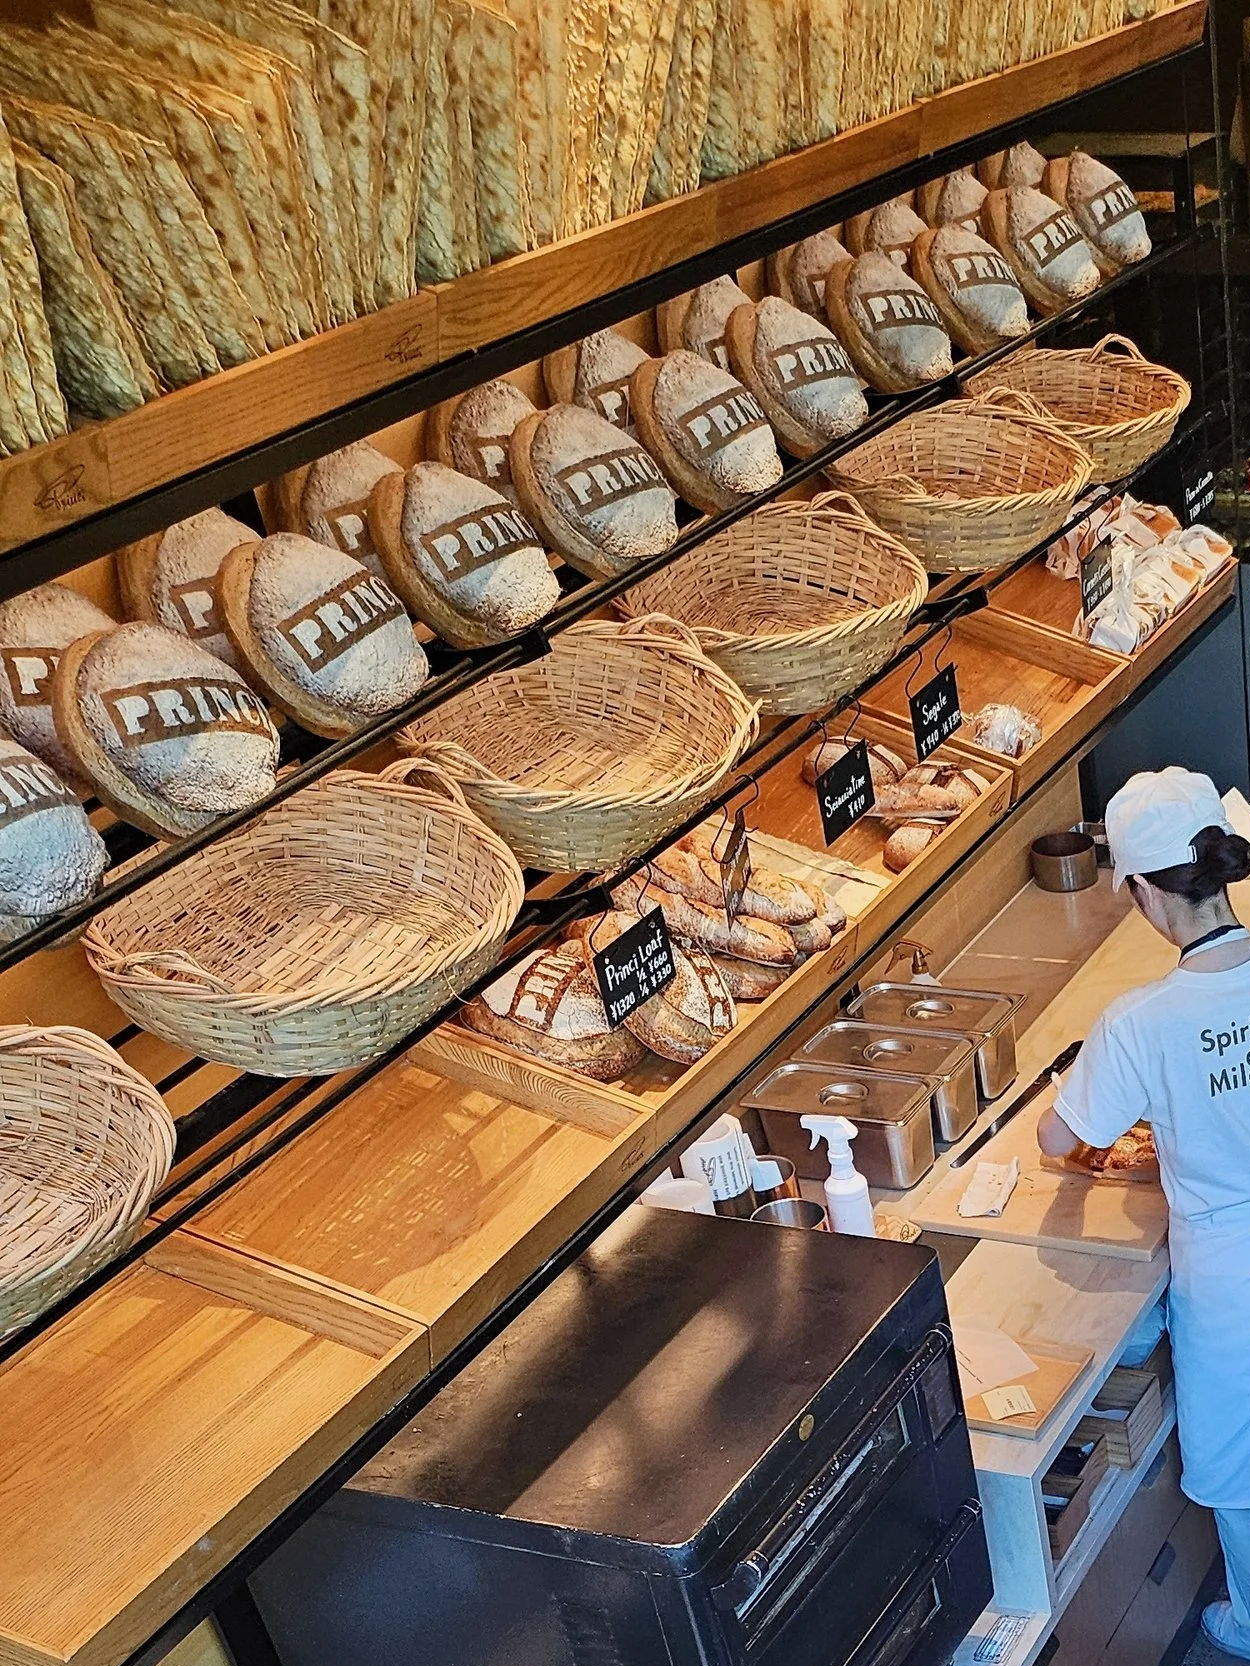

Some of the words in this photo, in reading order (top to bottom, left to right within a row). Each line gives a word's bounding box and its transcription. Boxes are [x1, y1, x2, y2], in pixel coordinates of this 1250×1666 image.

[604, 953, 639, 992] Princi
[637, 928, 663, 964] Loaf
[648, 951, 669, 974] ¥660
[650, 963, 673, 988] ¥330
